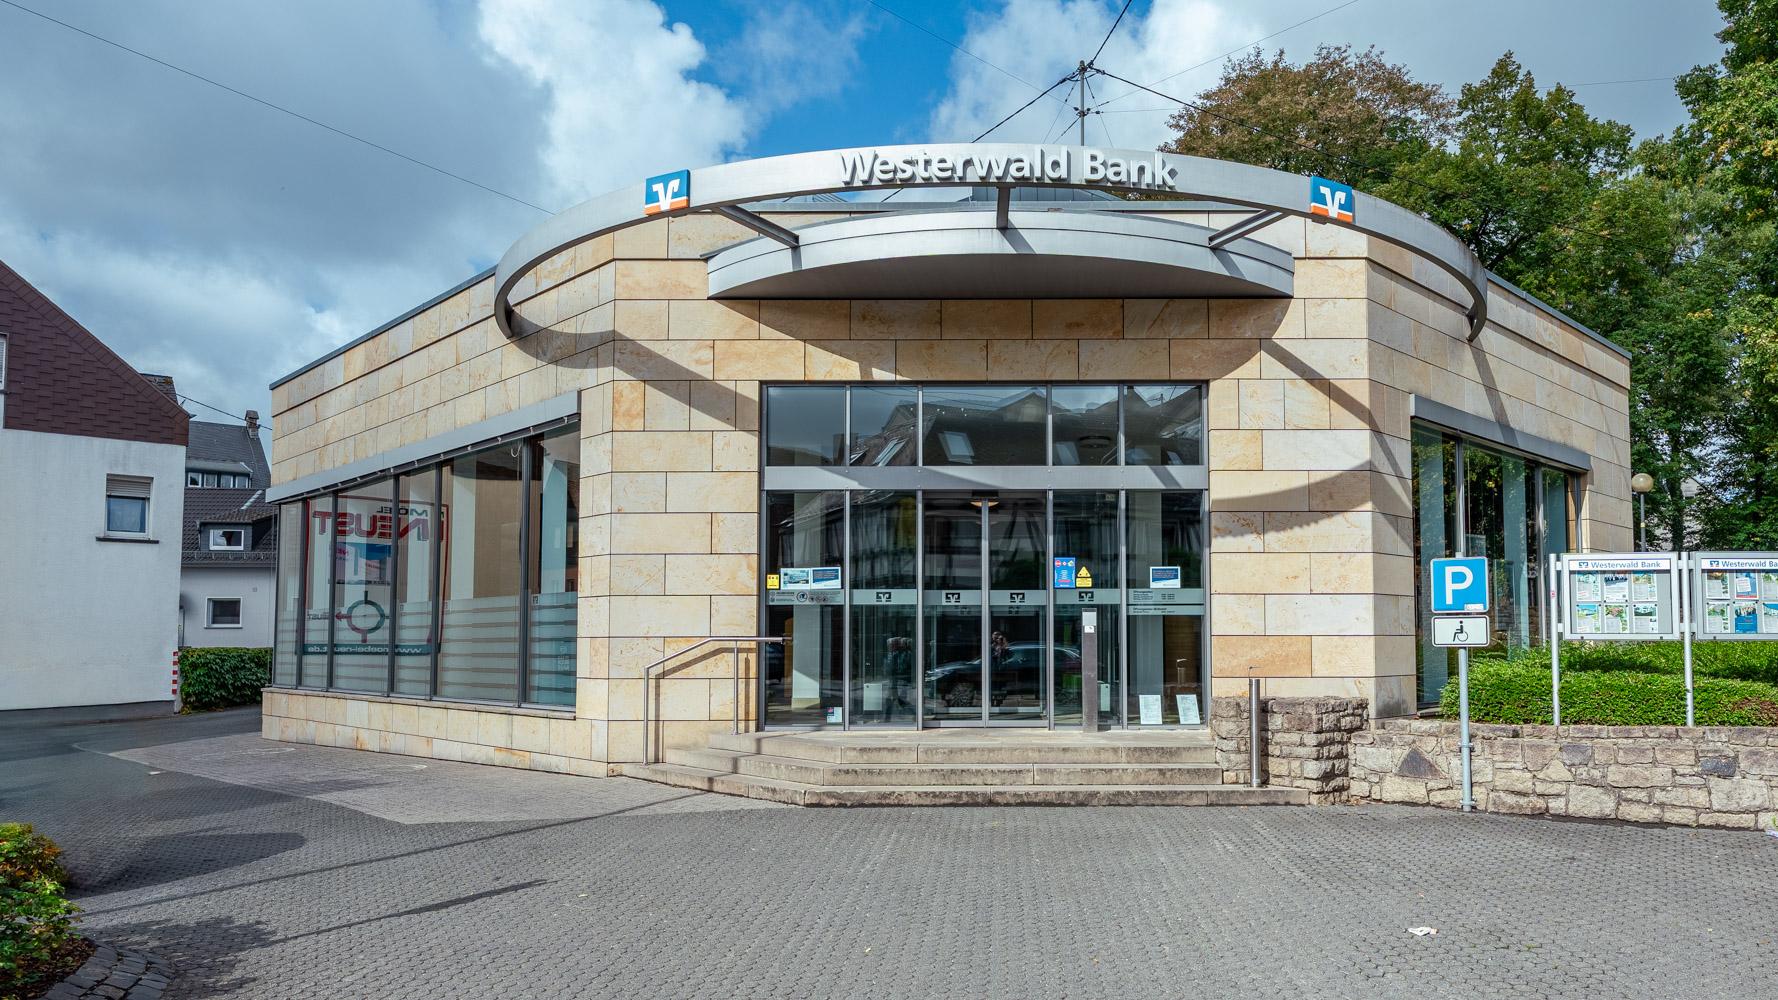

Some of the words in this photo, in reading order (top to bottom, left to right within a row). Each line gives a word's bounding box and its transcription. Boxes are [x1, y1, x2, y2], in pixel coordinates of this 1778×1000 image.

[840, 147, 1071, 186] Westerwald
[1083, 152, 1178, 190] Bank
[1590, 560, 1639, 569] Westerwald
[1641, 560, 1661, 568] Bank
[1721, 560, 1767, 568] Westerwald
[1445, 565, 1474, 605] P
